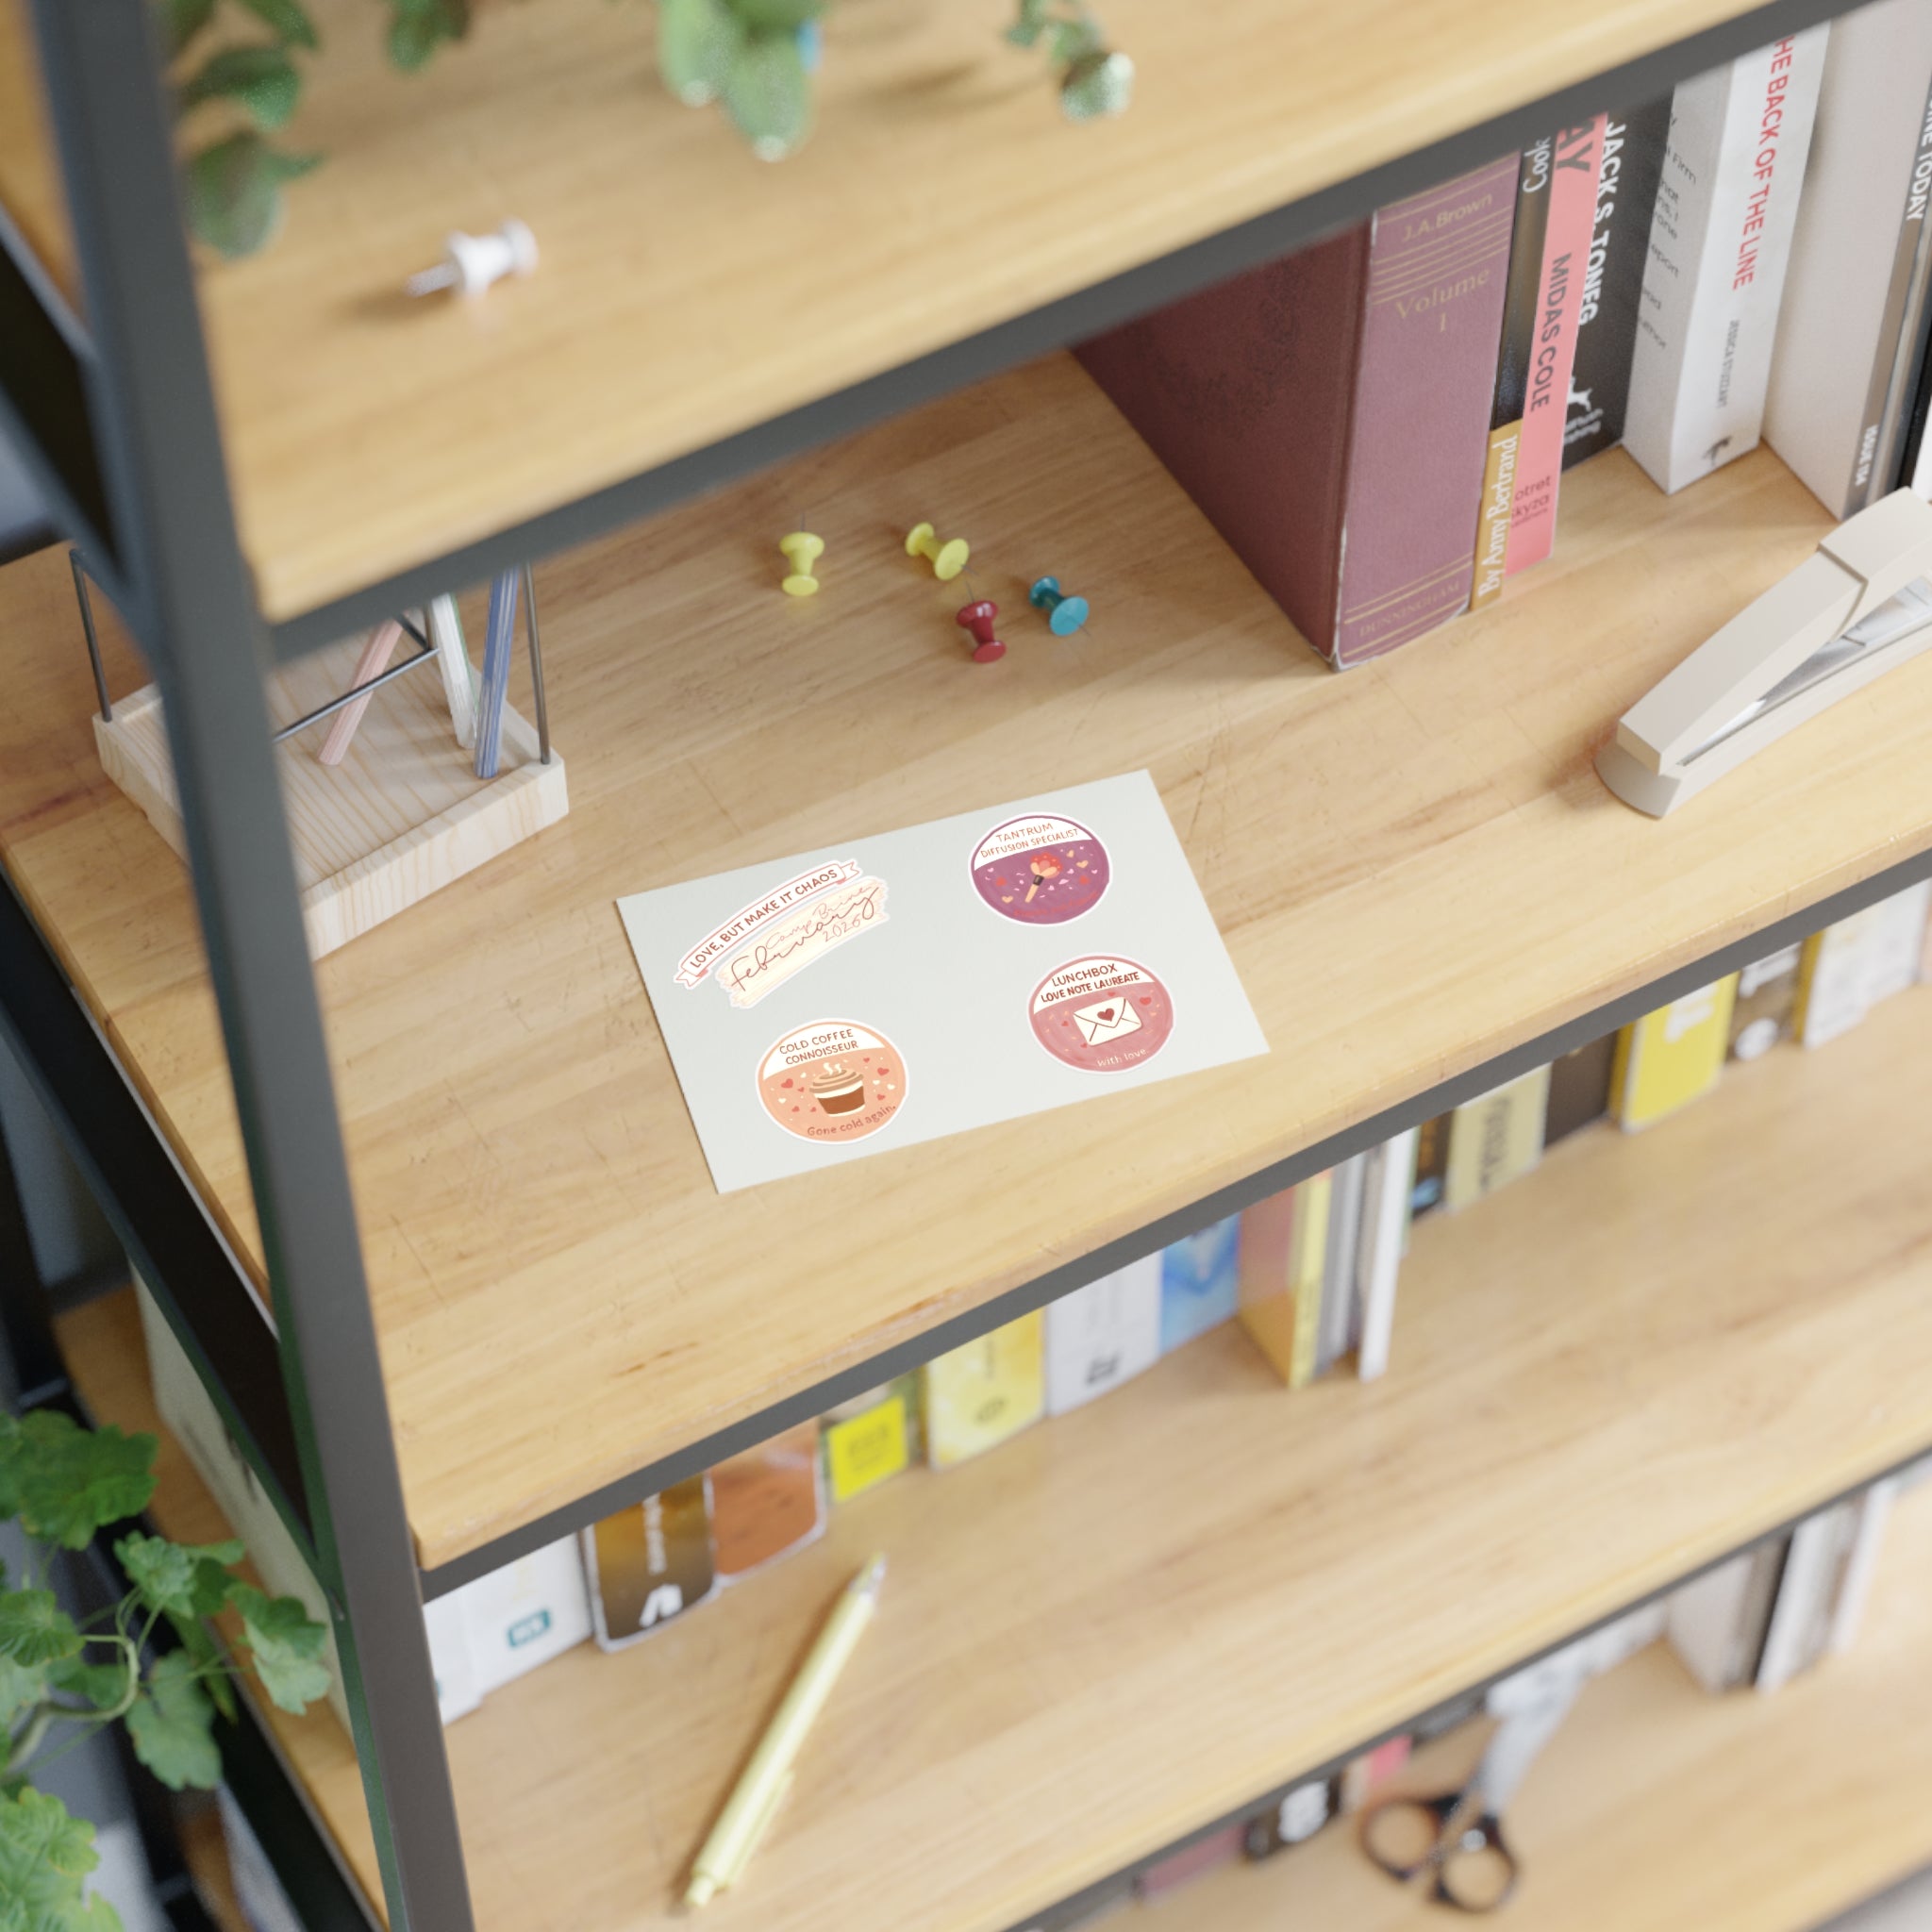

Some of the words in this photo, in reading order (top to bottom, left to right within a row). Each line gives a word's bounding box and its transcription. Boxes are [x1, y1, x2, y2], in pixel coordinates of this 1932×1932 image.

[1757, 74, 1789, 145] BACK
[1523, 136, 1551, 192] Cook
[1597, 122, 1626, 193] JACK
[1753, 148, 1776, 182] OF
[1906, 152, 1932, 221] TODAY
[1742, 184, 1771, 237] THE
[1732, 236, 1755, 291] LINE
[1395, 270, 1490, 320] Volume
[1542, 253, 1573, 343] MIDAS
[1530, 344, 1555, 413] COLE
[1487, 434, 1519, 521] Bertrand
[1478, 569, 1505, 598] By
[980, 841, 1029, 858] DIFFUSION
[1030, 828, 1078, 846] SPECIALIST
[996, 823, 1054, 842] TANTRUM
[690, 941, 724, 968] LOVE,
[721, 923, 745, 941] BUT
[744, 899, 779, 926] MAKE
[777, 891, 792, 907] IT
[794, 869, 838, 895] CHAOS
[823, 913, 861, 942] 2026
[1041, 989, 1066, 1003] LOVE
[1067, 983, 1092, 996] NOTE
[1093, 972, 1140, 990] LAUREATE
[1052, 963, 1118, 988] LUNCHBOX
[779, 1040, 809, 1055] COLD
[811, 1028, 854, 1045] COFFEE
[785, 1040, 858, 1065] CONNOISSEUR
[1097, 1053, 1123, 1067] with
[808, 1126, 837, 1136] Gone
[840, 1120, 864, 1132] cold
[865, 1106, 896, 1124] again.
